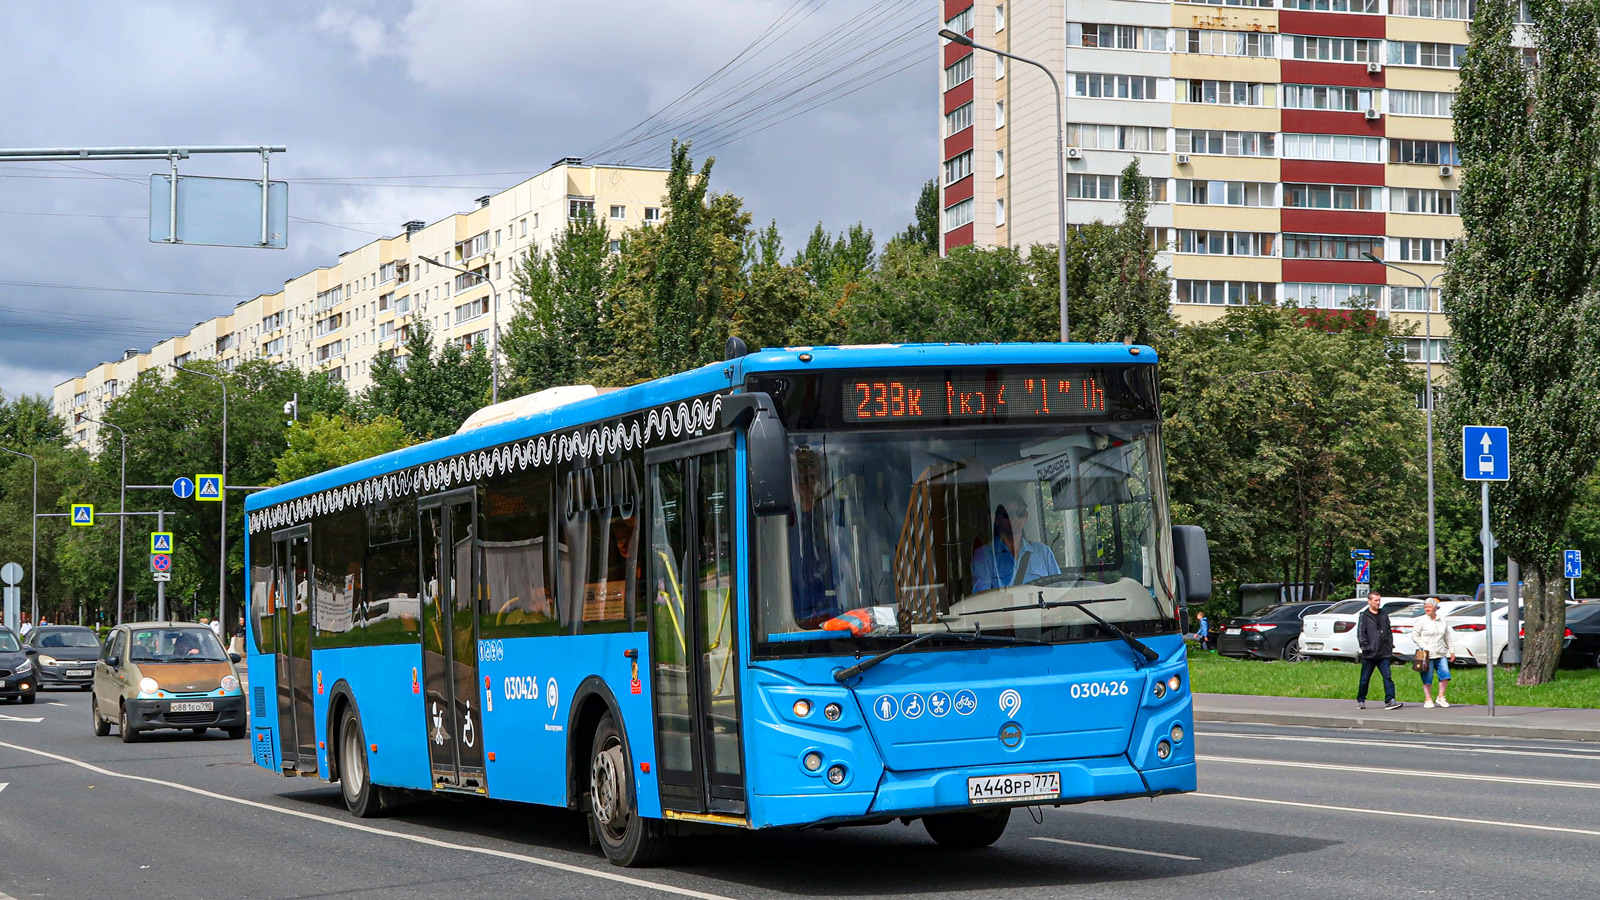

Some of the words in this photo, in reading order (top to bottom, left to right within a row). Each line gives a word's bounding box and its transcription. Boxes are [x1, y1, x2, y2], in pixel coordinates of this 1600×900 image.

[504, 675, 539, 700] 030426
[1070, 680, 1129, 699] 030426
[1034, 774, 1056, 788] 777
